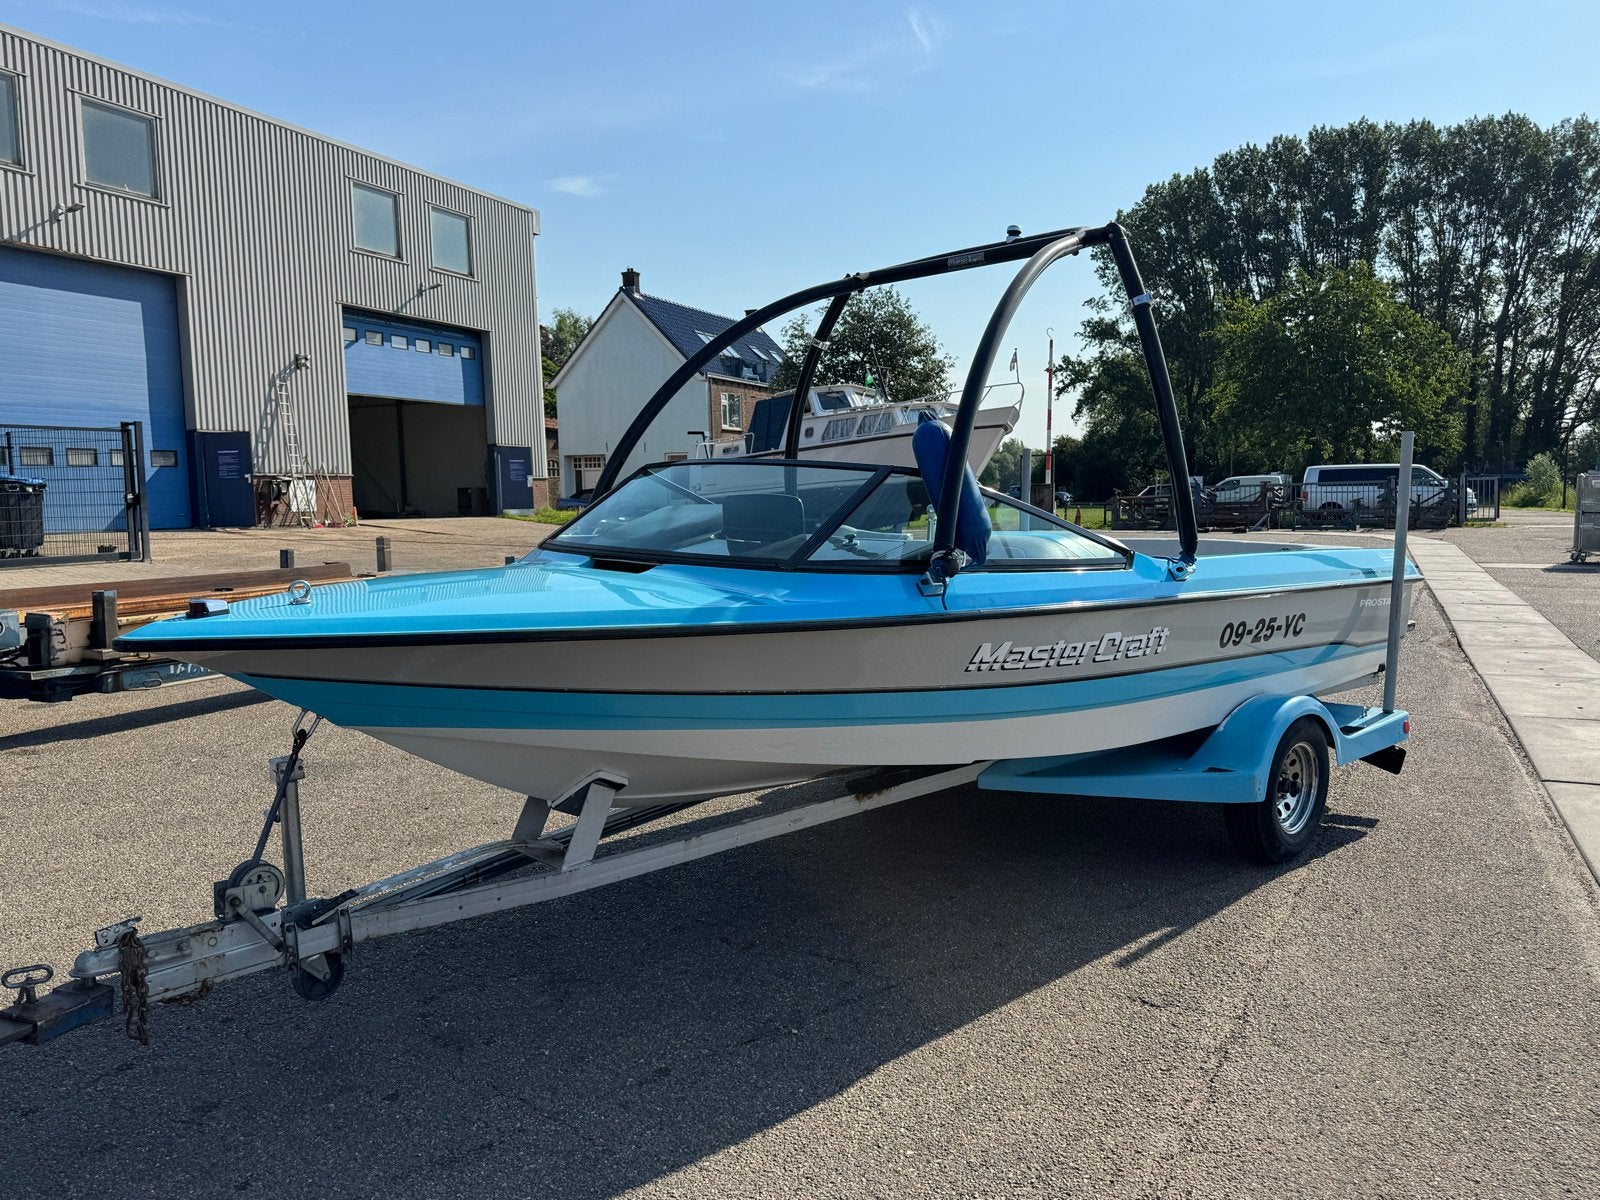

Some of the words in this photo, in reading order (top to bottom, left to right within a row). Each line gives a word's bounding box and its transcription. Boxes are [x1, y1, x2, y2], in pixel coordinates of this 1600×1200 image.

[1359, 597, 1391, 608] PROSTA
[1219, 612, 1306, 648] 09-25-YC
[964, 626, 1170, 673] MasterCraft
